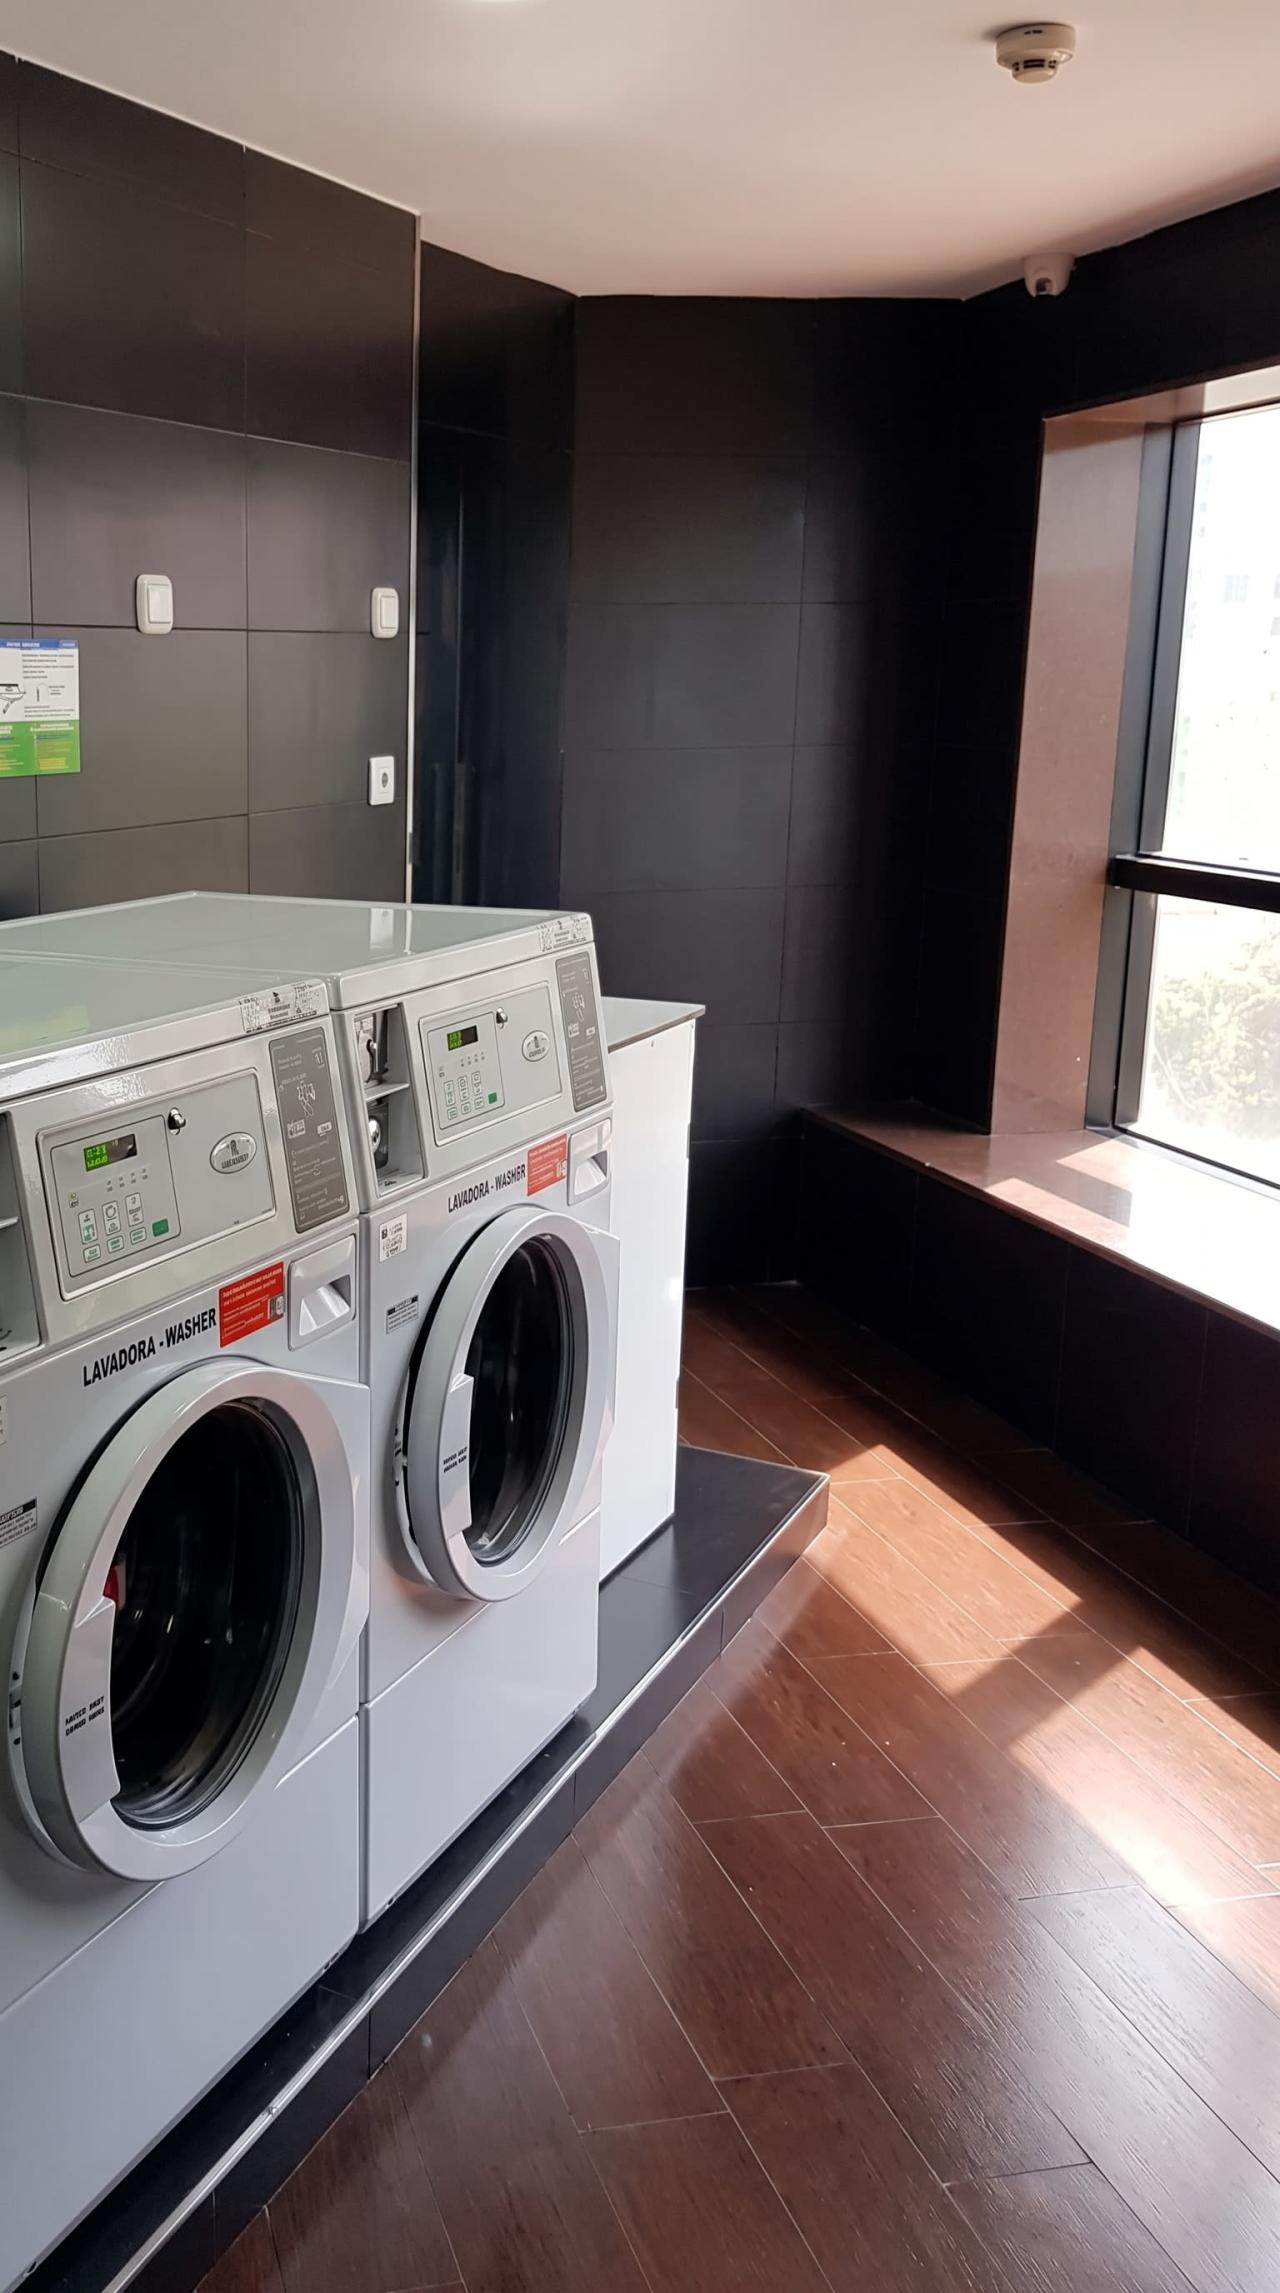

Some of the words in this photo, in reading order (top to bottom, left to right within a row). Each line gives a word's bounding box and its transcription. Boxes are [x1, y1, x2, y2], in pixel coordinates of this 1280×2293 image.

[447, 1180, 490, 1213] LAVADORA
[494, 1164, 526, 1192] WASHER
[83, 1336, 156, 1387] LAVADORA
[164, 1308, 217, 1348] WASHER
